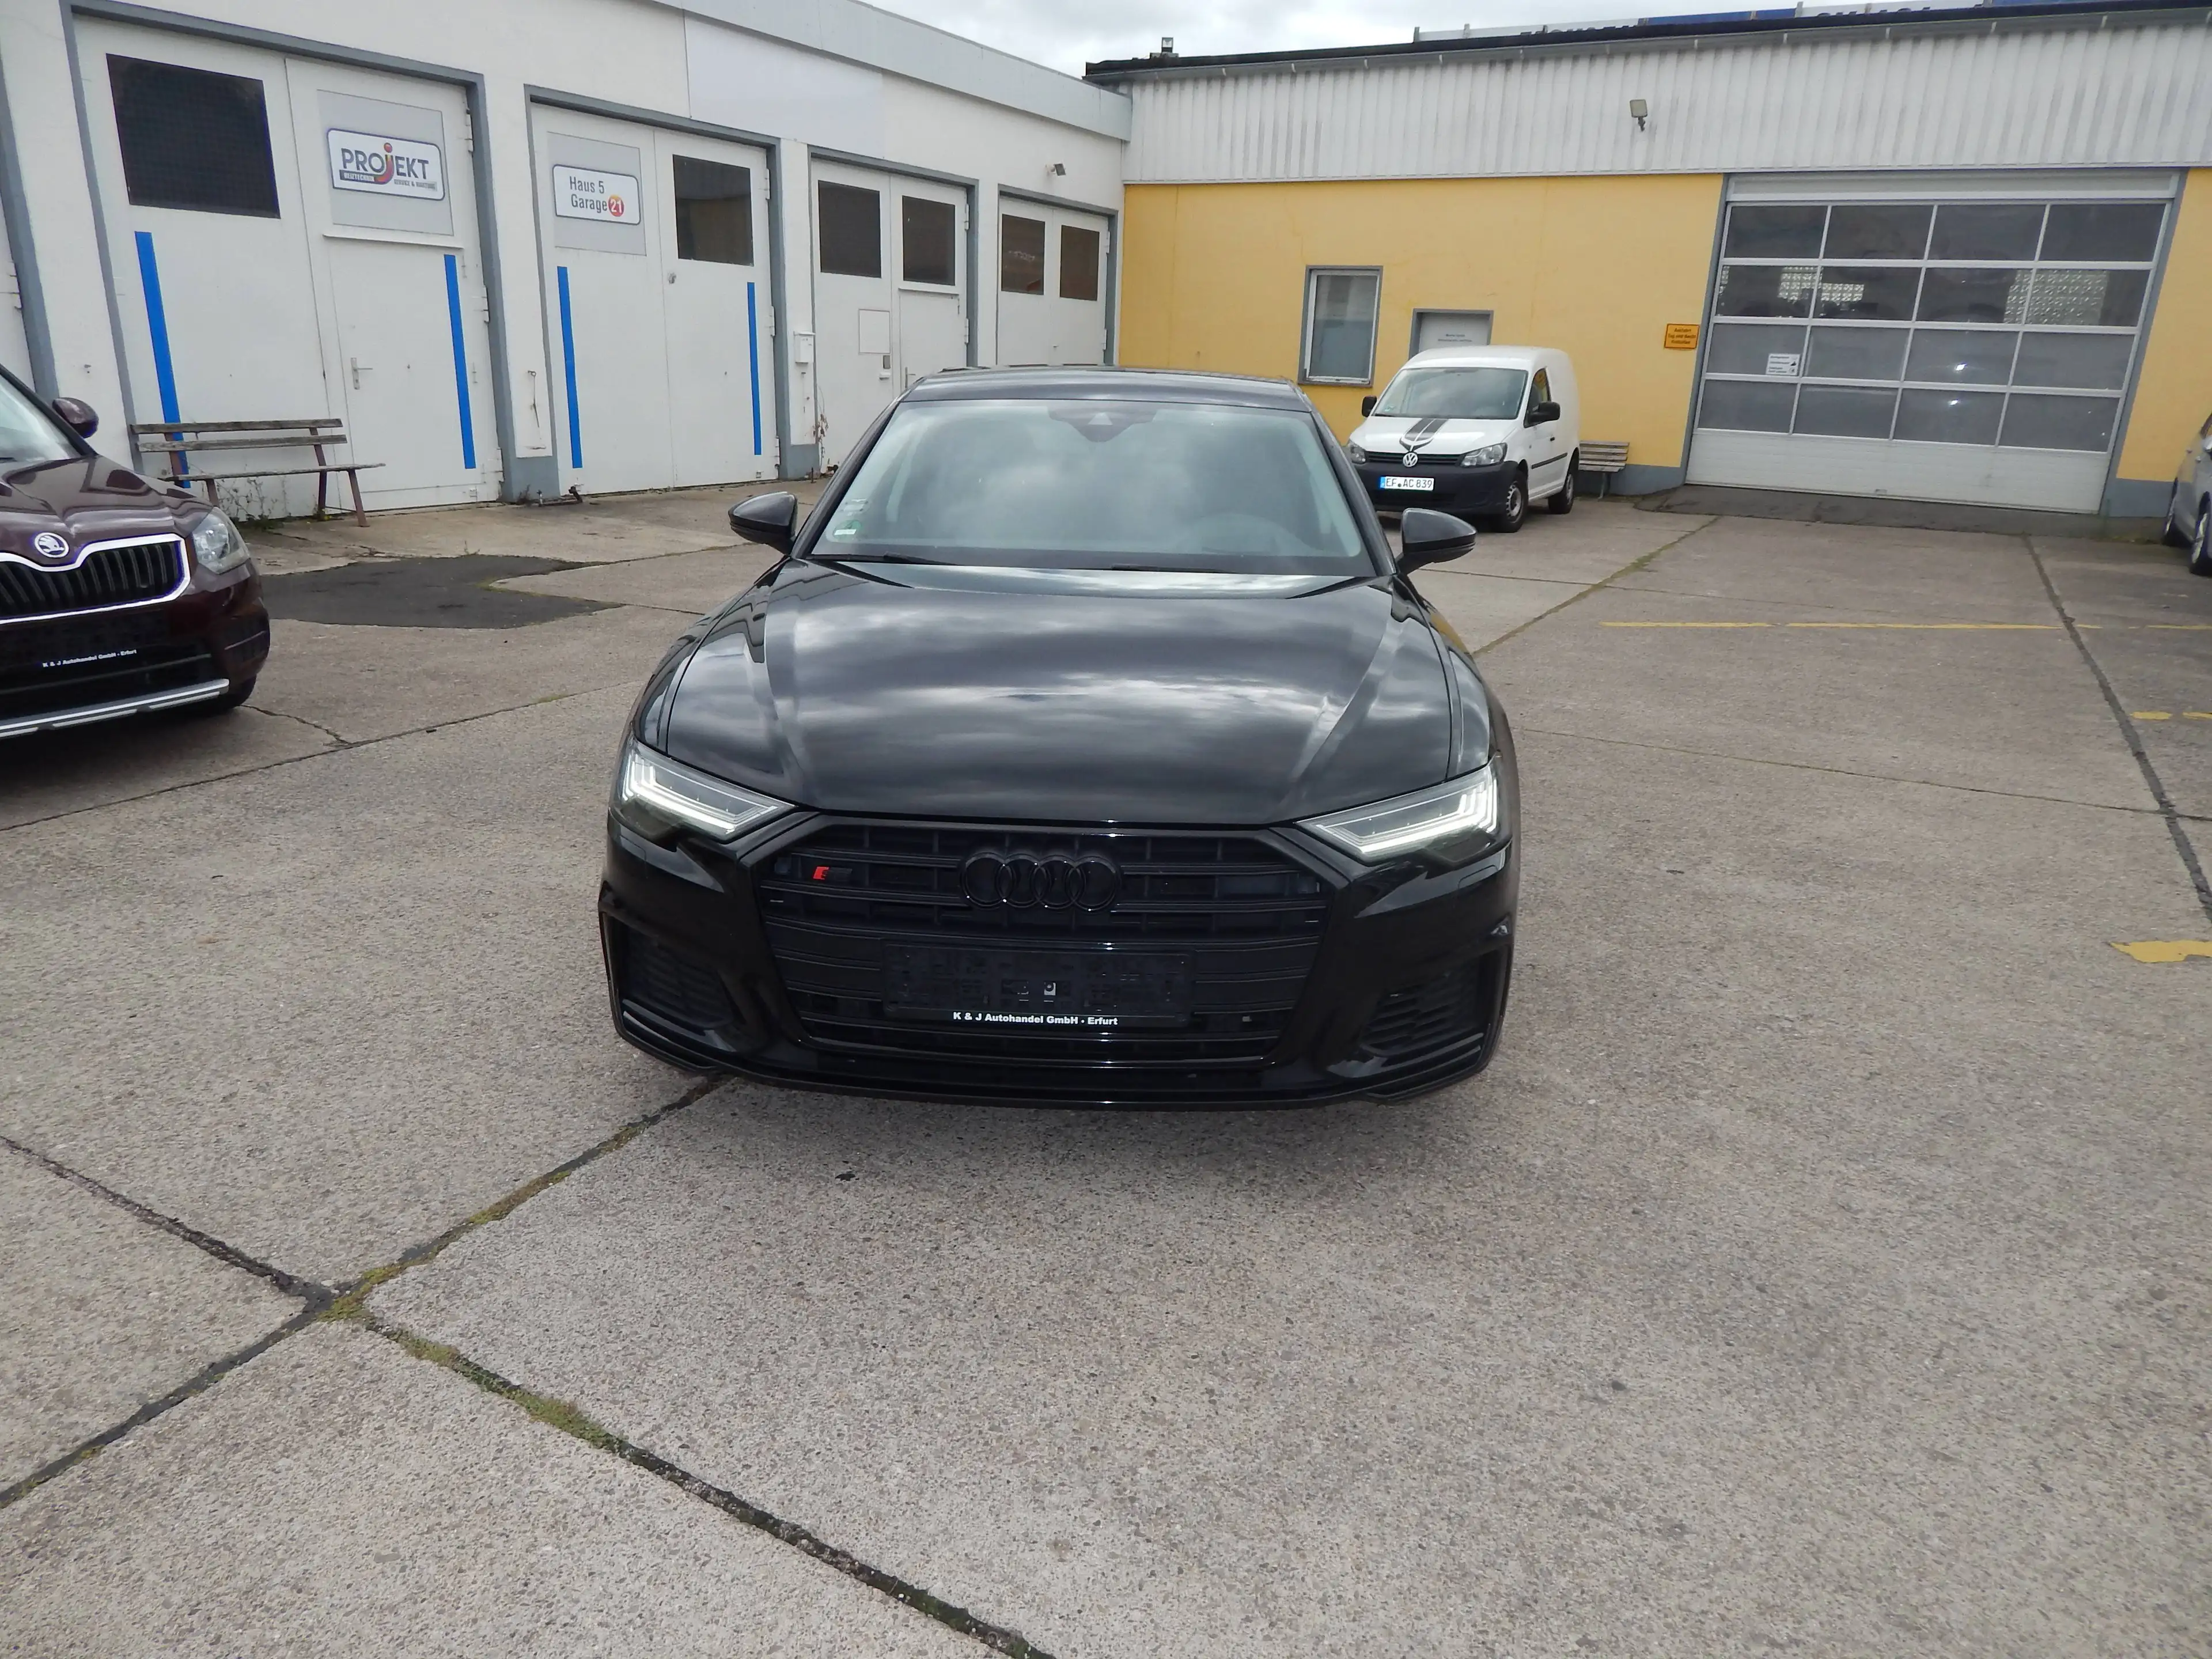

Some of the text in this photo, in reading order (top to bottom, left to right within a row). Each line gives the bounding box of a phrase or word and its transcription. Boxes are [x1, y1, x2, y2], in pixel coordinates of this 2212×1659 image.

[569, 176, 604, 194] Haus 5
[571, 194, 622, 213] Garage 21
[1386, 478, 1433, 488] EF AC 839
[63, 655, 97, 665] Autohandel
[953, 1012, 961, 1020] K
[964, 1012, 973, 1020] &
[984, 1013, 1044, 1023] Autohandel
[1046, 1016, 1078, 1024] GmbH
[1087, 1017, 1118, 1025] Erfurt
